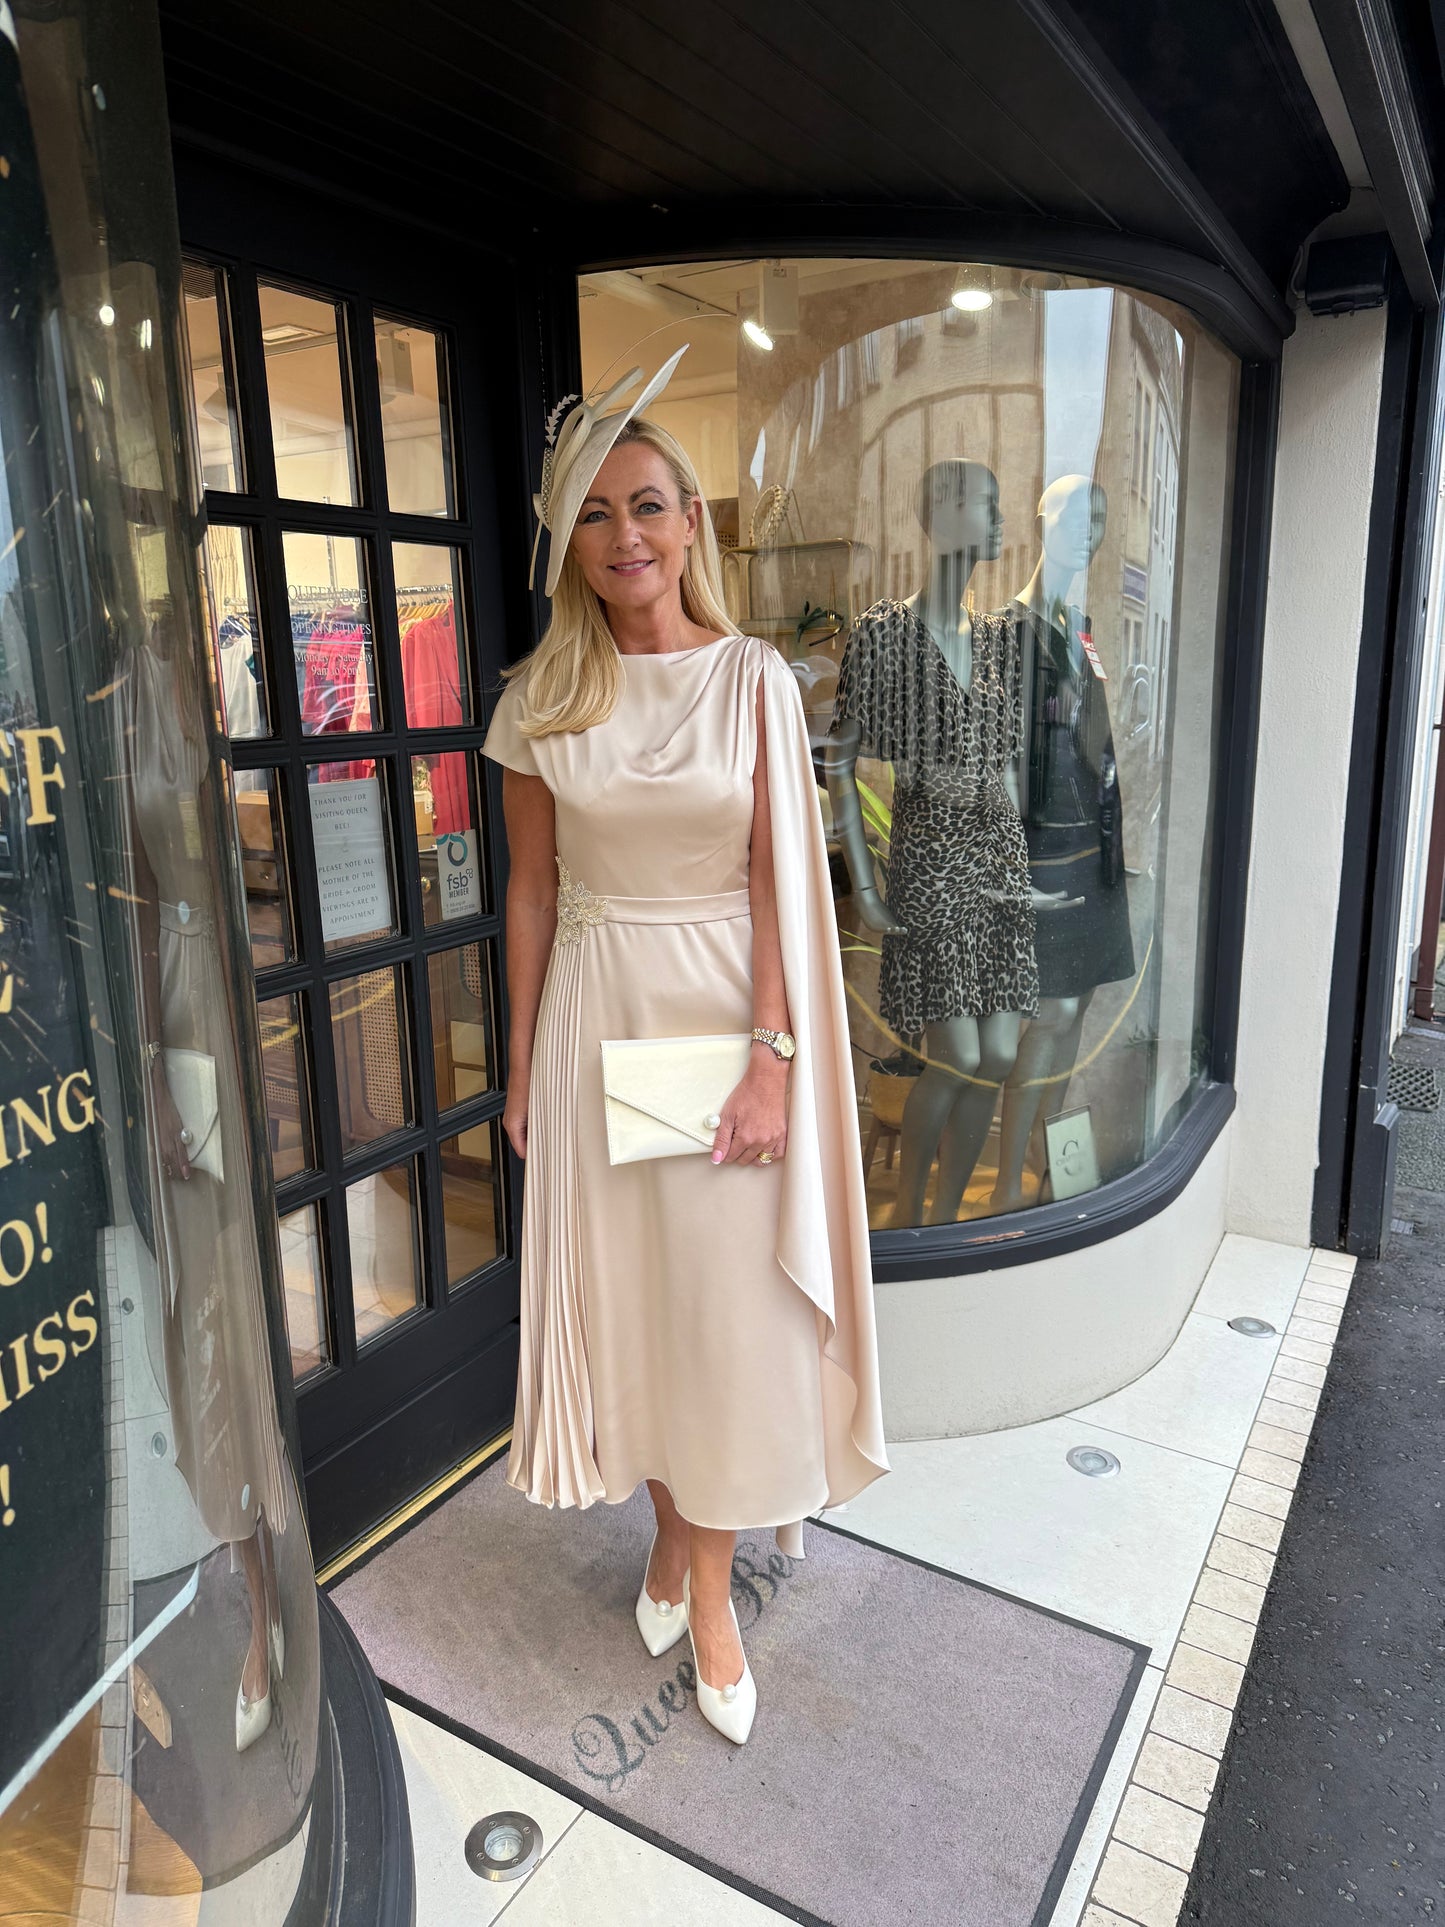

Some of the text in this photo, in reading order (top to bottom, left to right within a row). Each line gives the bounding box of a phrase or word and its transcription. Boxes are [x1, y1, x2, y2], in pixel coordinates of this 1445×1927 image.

[287, 585, 368, 604] QUEEN BEE
[291, 621, 372, 635] OPENING TIMES
[295, 652, 373, 665] Monday Saturday
[311, 664, 360, 678] 9am to 5pm
[314, 797, 336, 806] THANK
[354, 793, 367, 801] FOR
[315, 806, 368, 819] VISITING QUEEN
[318, 863, 342, 873] PLEASE
[345, 860, 361, 868] NOTE
[322, 875, 349, 886] MOTHER
[362, 870, 374, 878] THE
[447, 871, 469, 891] fsb
[323, 890, 343, 899] BRIDE
[353, 883, 376, 893] GROOM
[449, 887, 469, 898] MEMBER
[322, 900, 355, 912] VIEWINGS
[330, 909, 375, 924] APPOINTMENT
